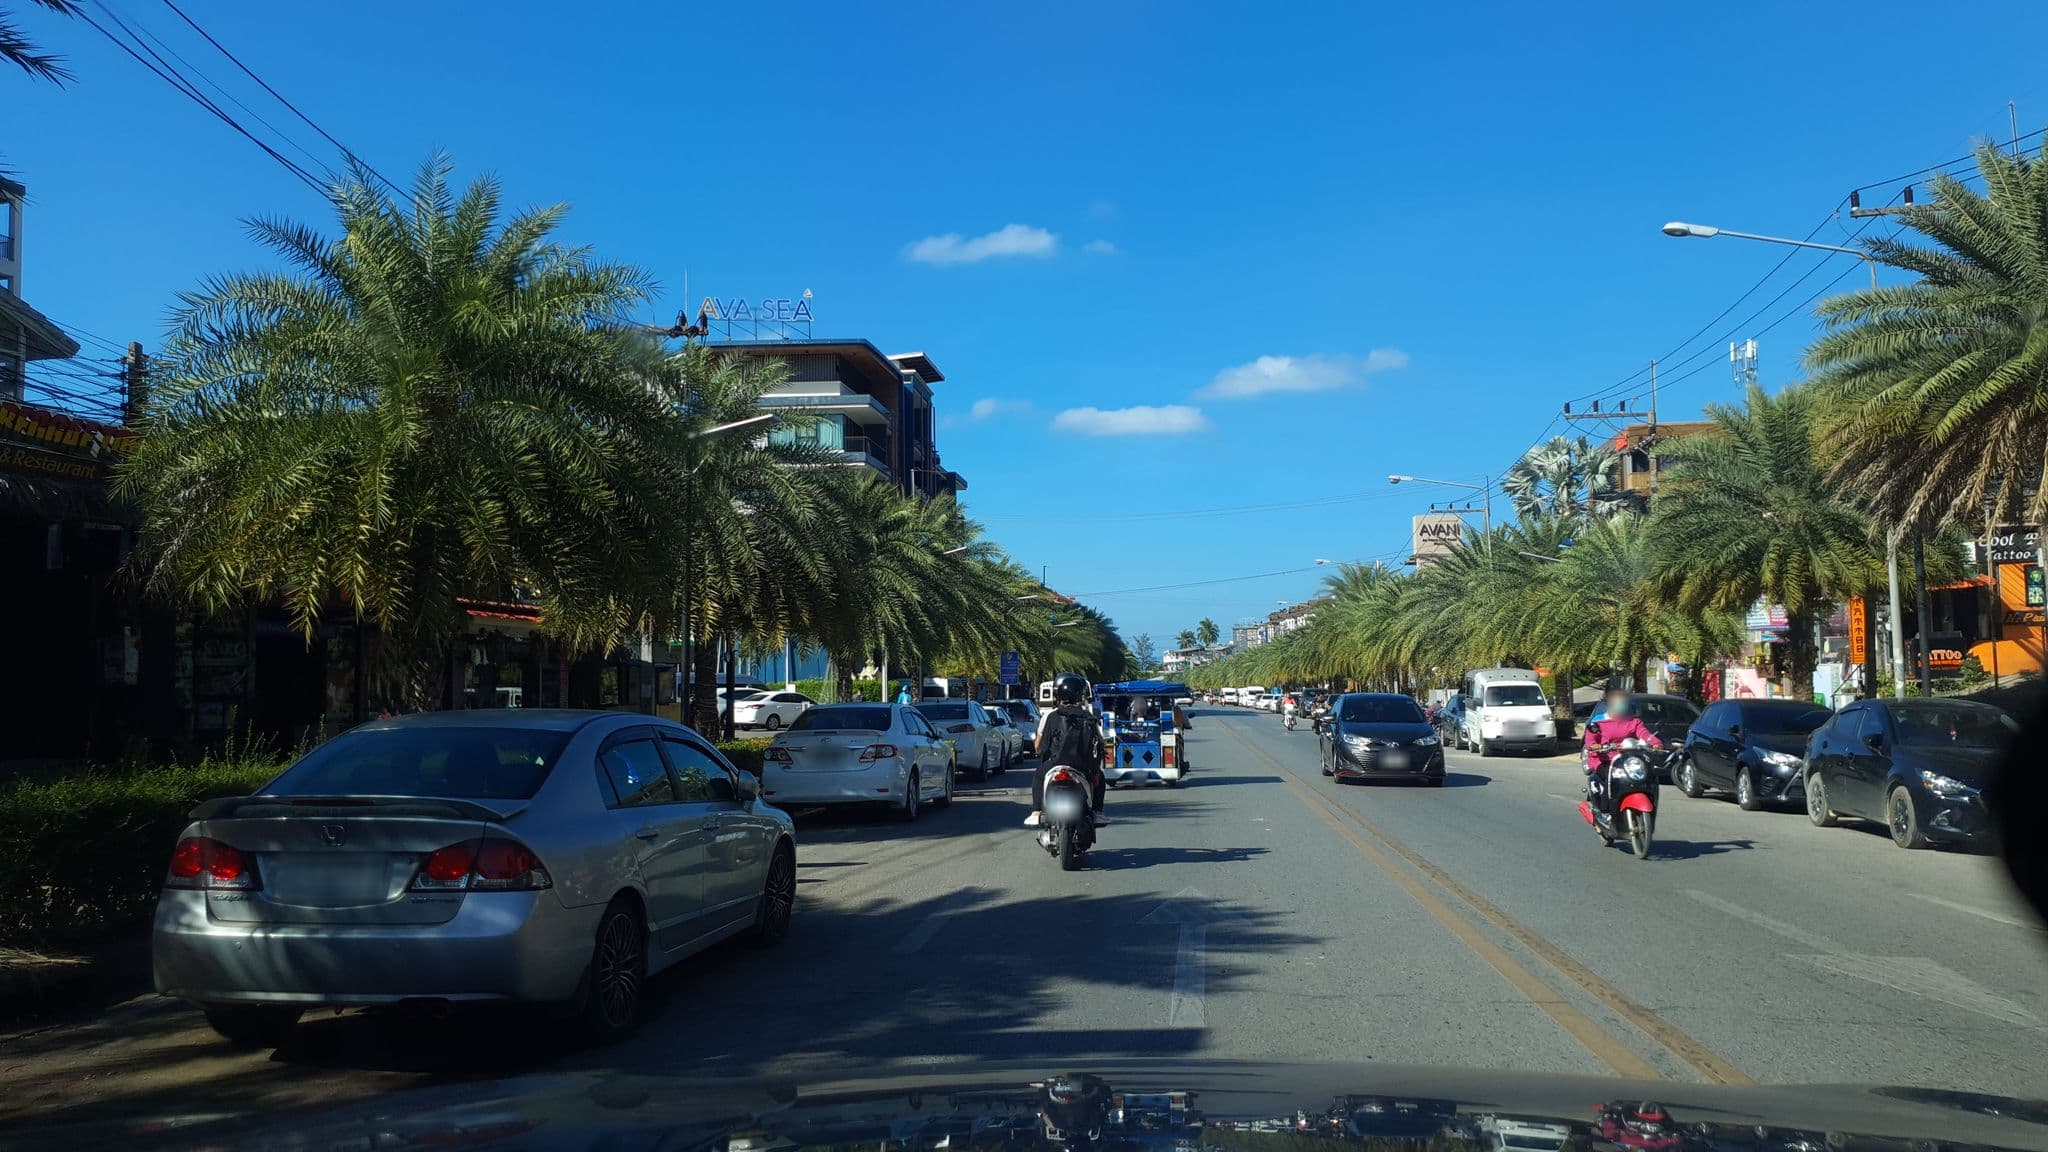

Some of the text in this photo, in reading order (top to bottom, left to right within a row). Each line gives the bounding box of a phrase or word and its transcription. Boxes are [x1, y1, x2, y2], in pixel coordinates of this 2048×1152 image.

[698, 296, 814, 321] AVA SEA
[12, 449, 97, 479] Restaurant
[1419, 523, 1461, 537] AVANI
[1978, 532, 2017, 547] Cool
